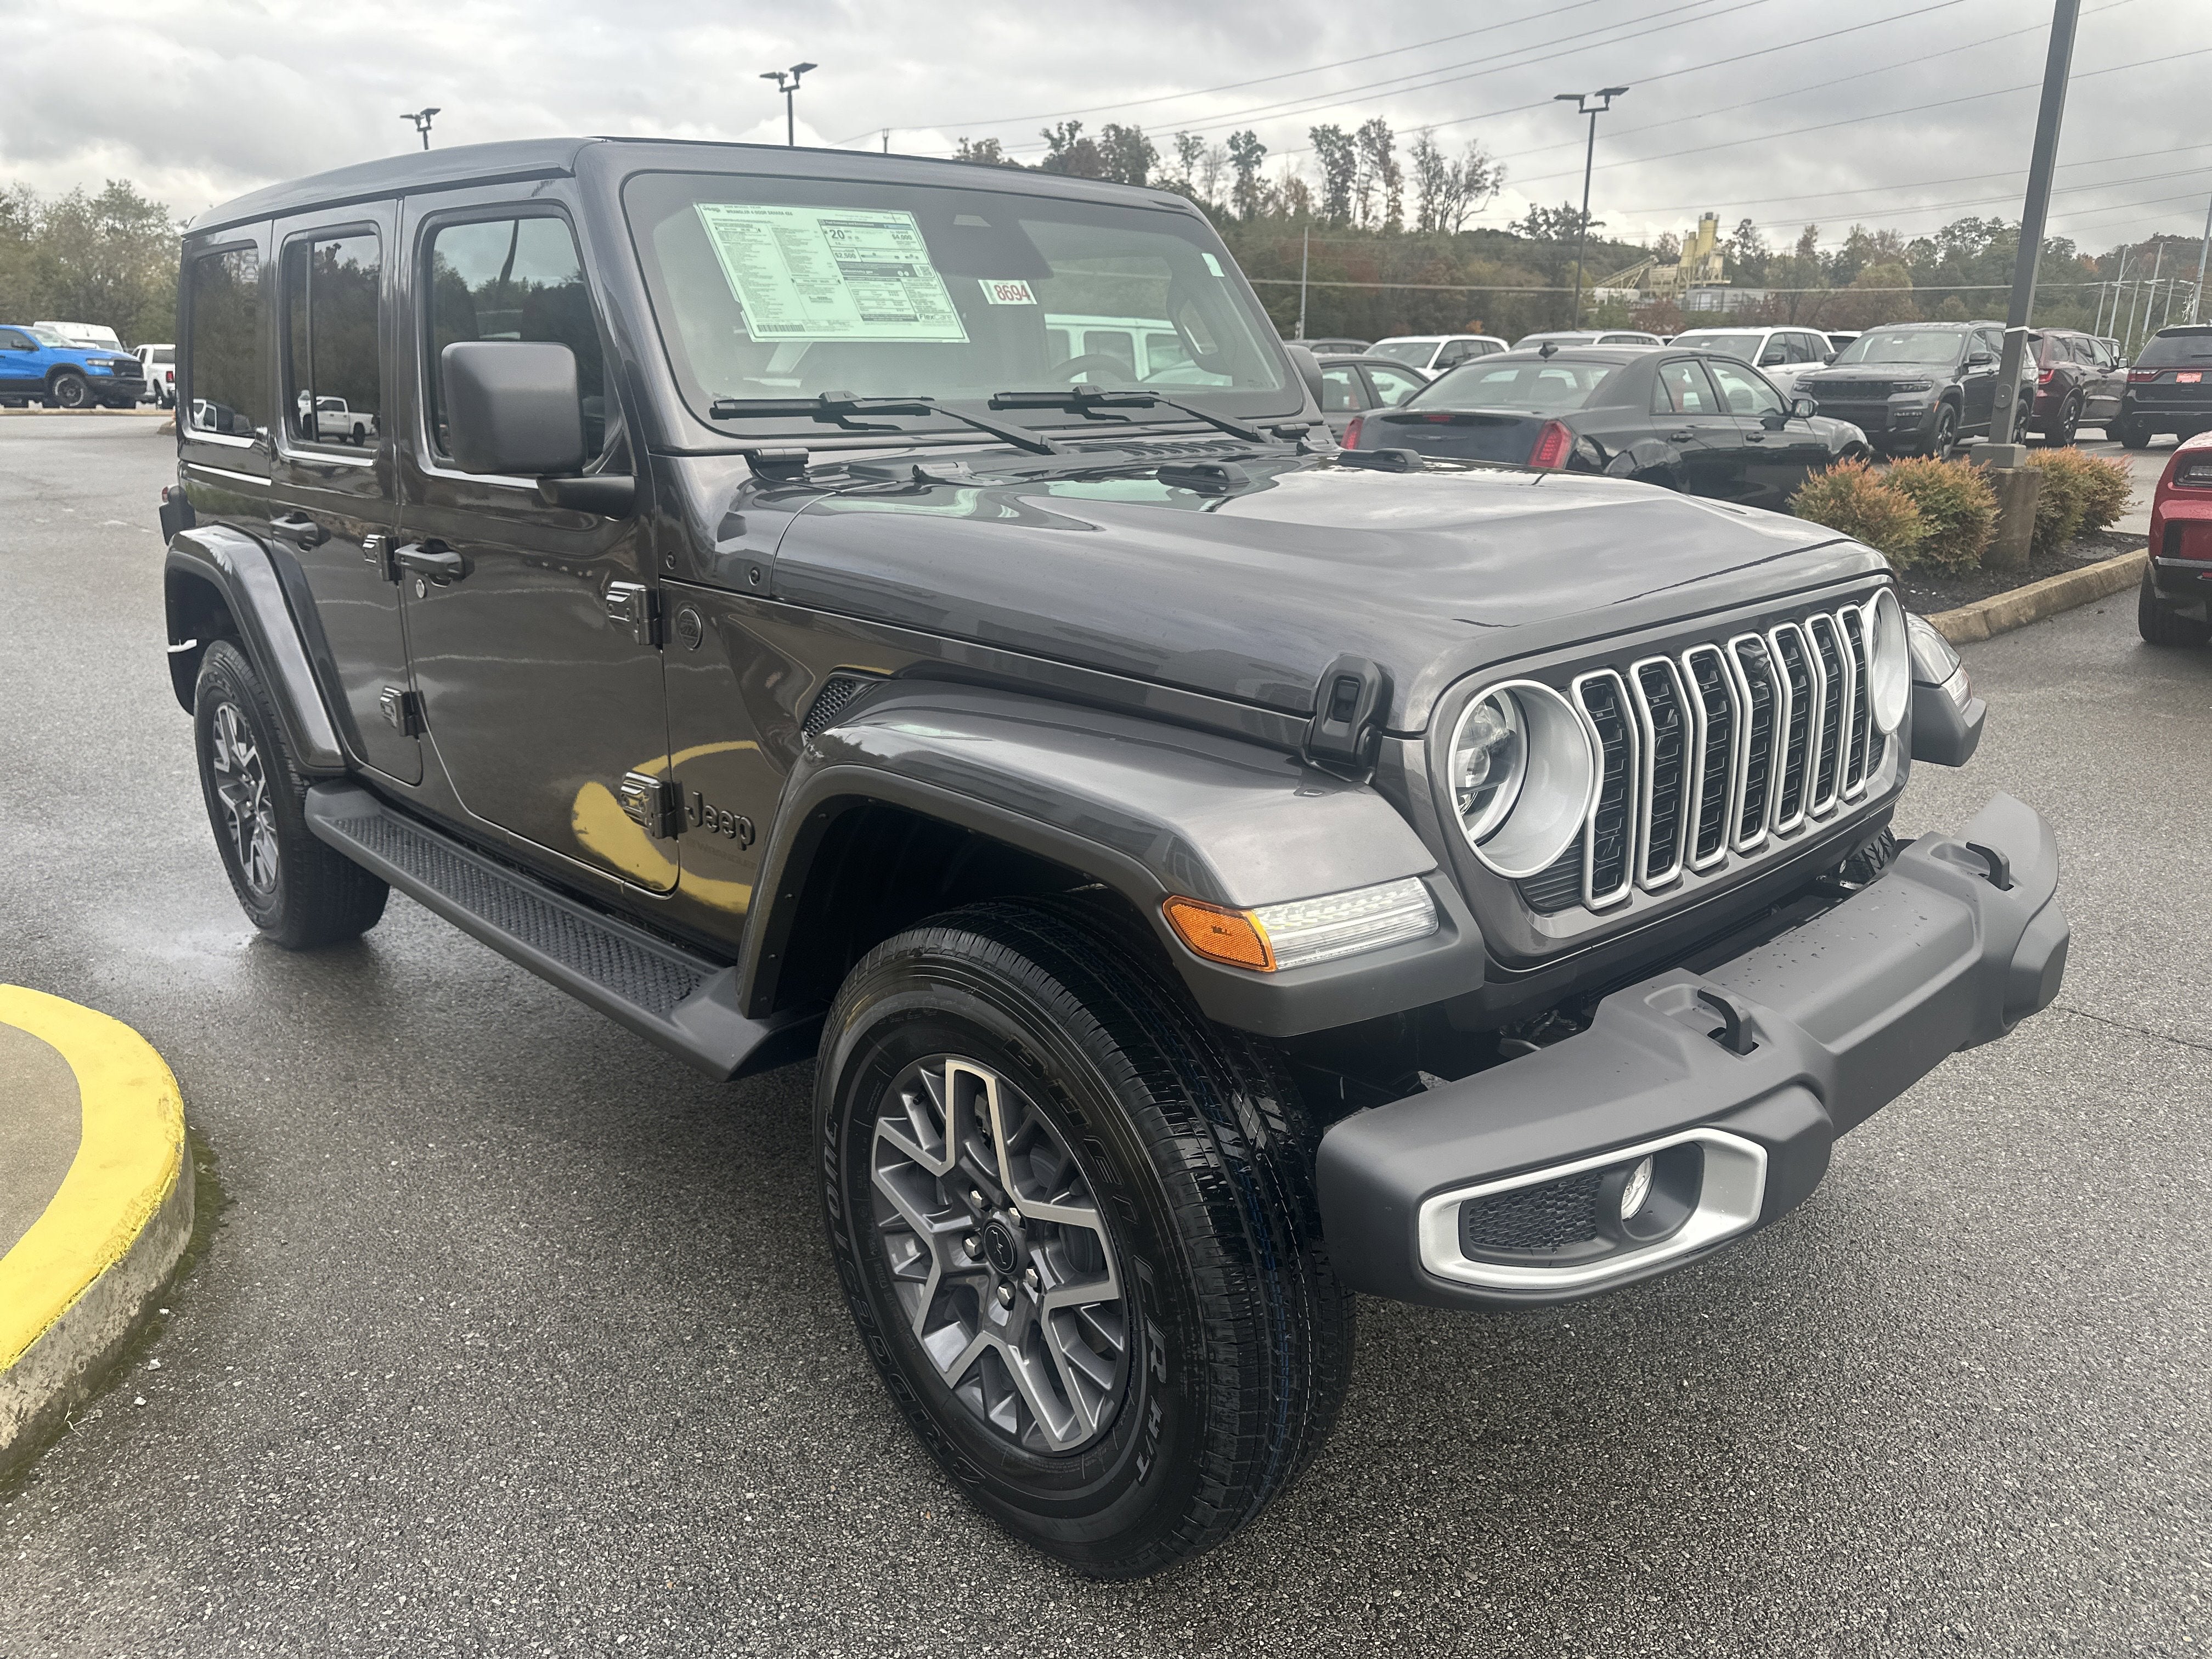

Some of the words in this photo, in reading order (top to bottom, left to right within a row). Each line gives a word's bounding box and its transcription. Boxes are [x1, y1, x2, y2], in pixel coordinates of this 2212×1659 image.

[830, 229, 845, 239] 20
[994, 285, 1030, 301] 8694
[684, 791, 755, 851] Jeep
[1003, 1035, 1167, 1384] DUELER
[1136, 1395, 1163, 1482] H/T
[822, 1107, 986, 1488] BRIDGESTONE
